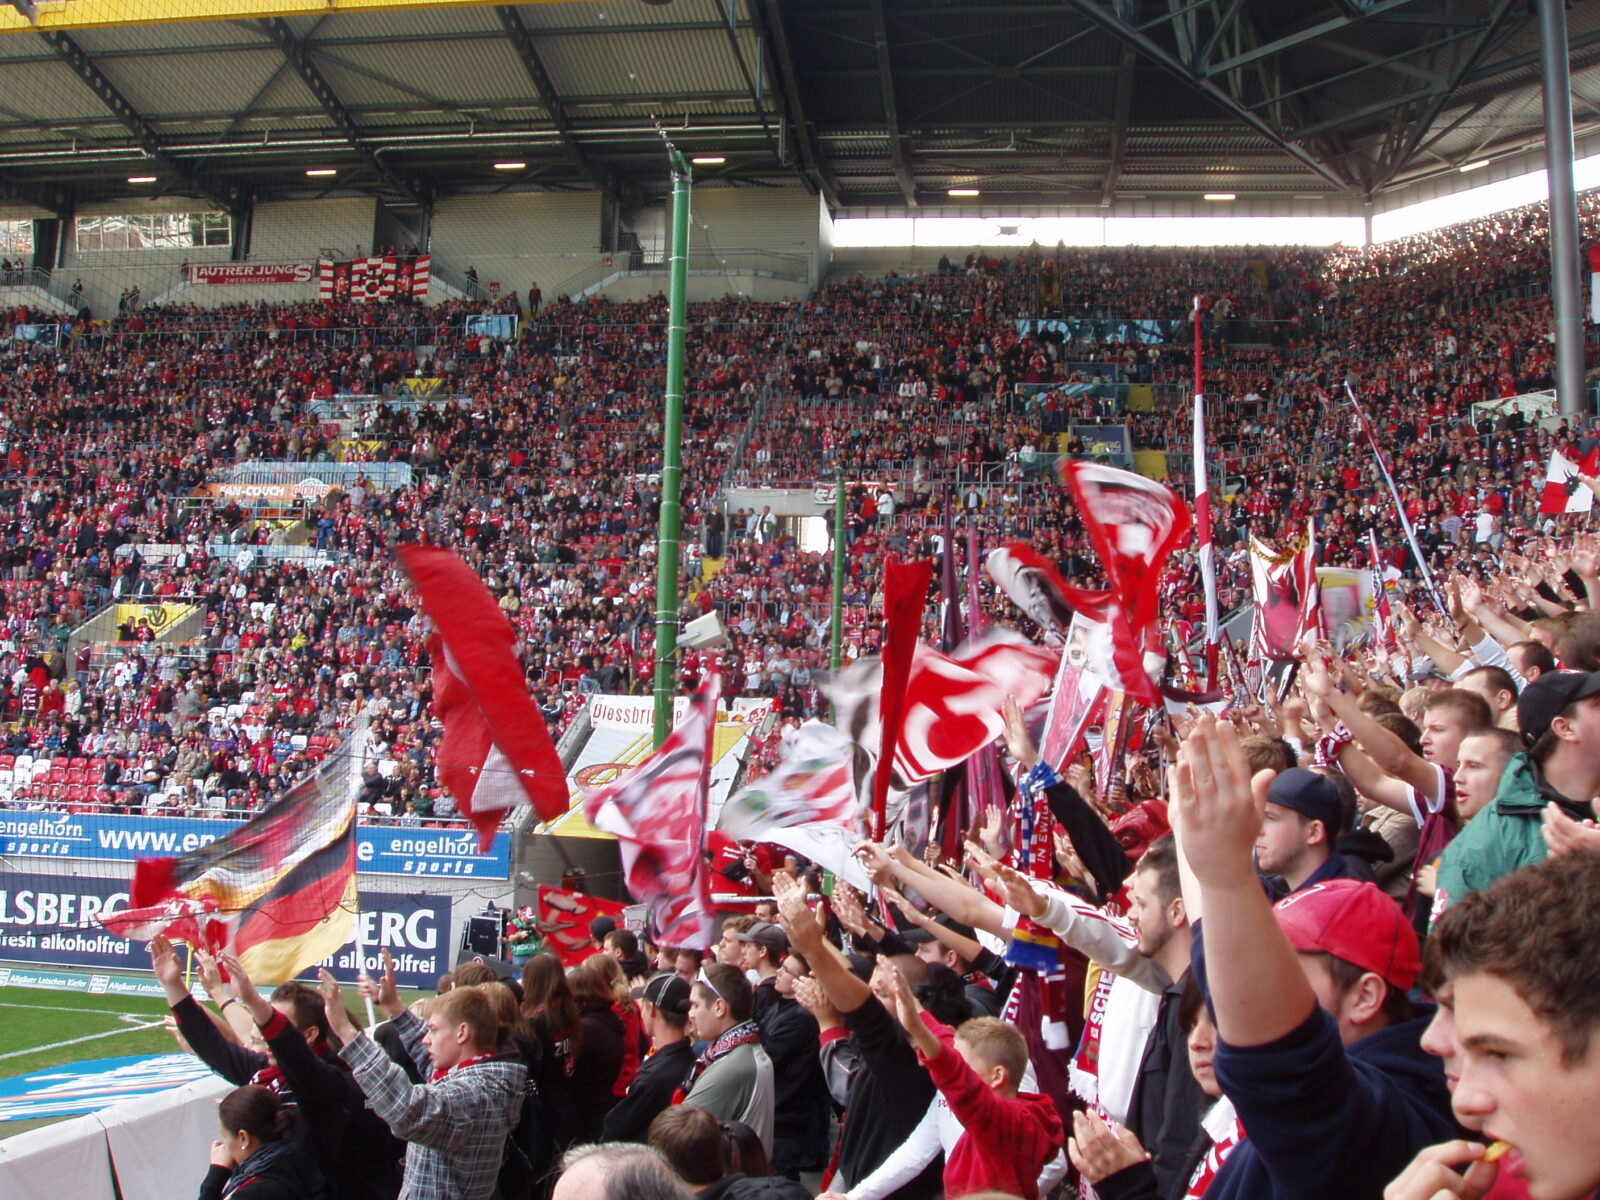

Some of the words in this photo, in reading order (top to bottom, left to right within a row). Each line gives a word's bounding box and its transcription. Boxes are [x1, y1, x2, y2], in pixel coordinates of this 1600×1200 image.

[192, 265, 254, 284] LAUTRER
[256, 264, 313, 282] JUNGS
[7, 841, 70, 855] sports
[403, 861, 474, 875] sports
[41, 932, 130, 955] alkoholfrei
